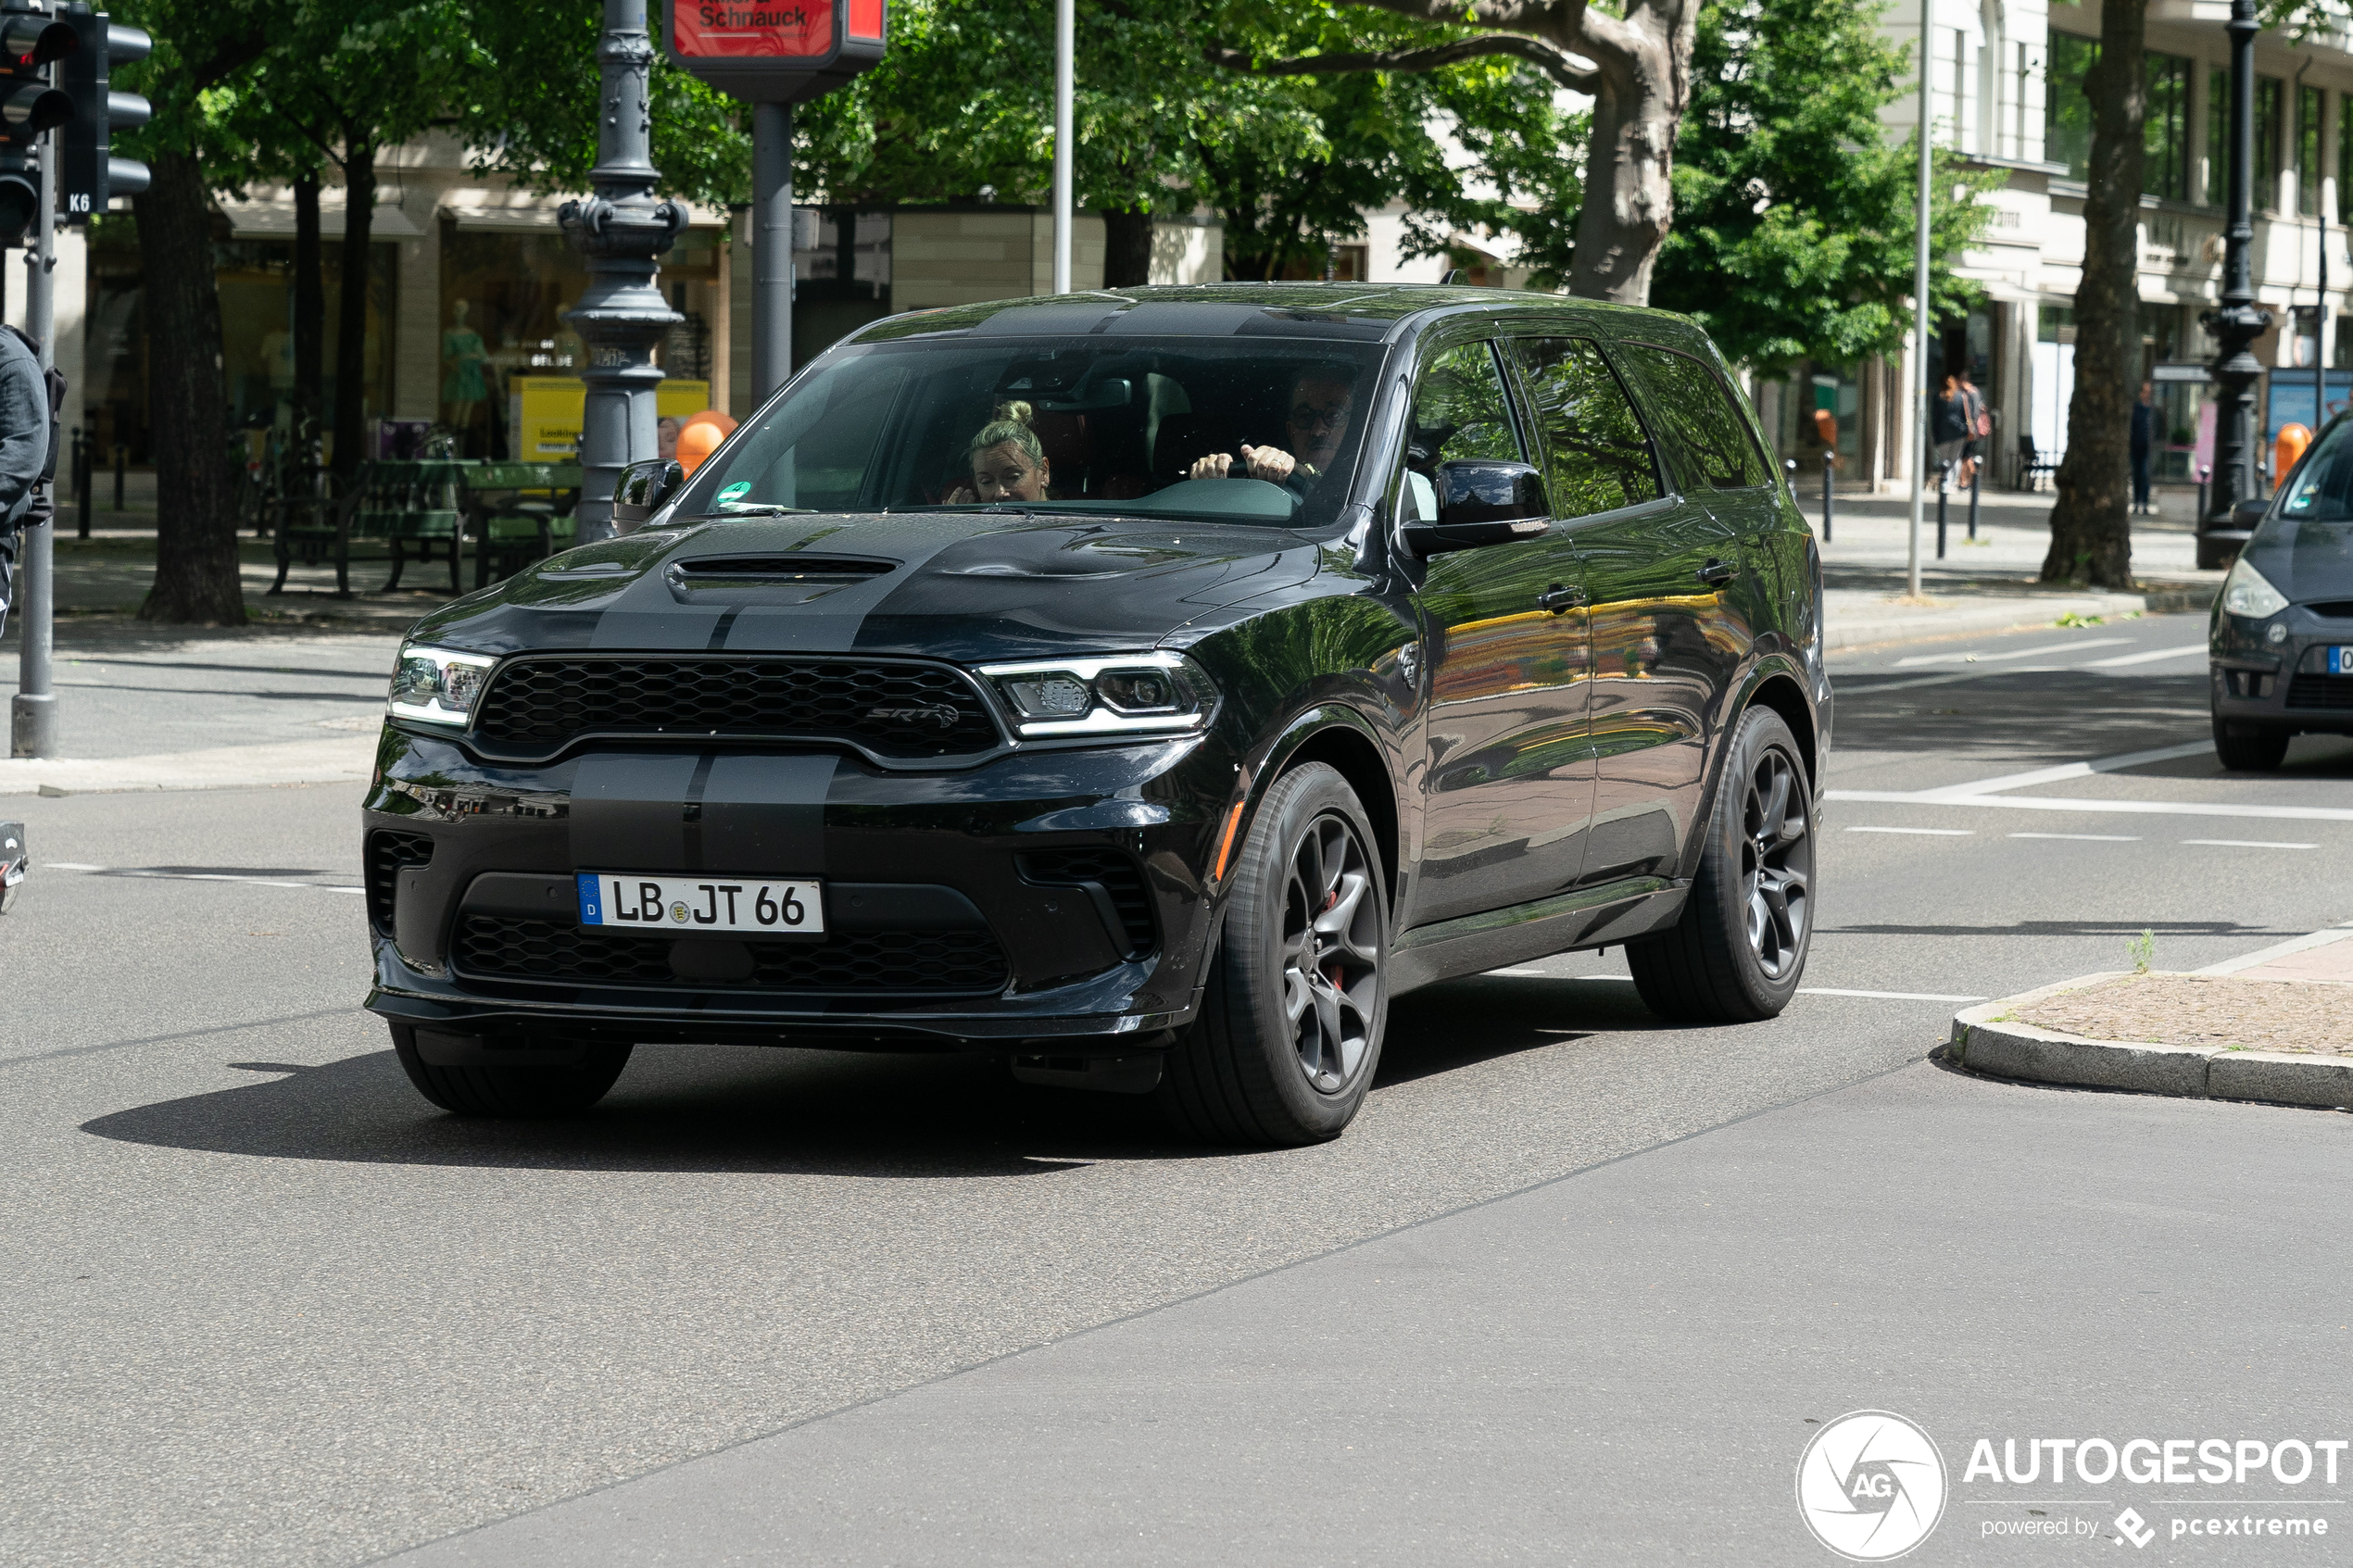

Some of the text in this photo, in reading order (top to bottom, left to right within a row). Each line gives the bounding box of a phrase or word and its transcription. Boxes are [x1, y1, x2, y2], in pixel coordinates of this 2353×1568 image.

[699, 6, 808, 27] Schnauck
[69, 193, 90, 212] K6
[866, 709, 940, 722] SRT
[587, 904, 596, 916] D
[613, 881, 805, 925] LB JT 66
